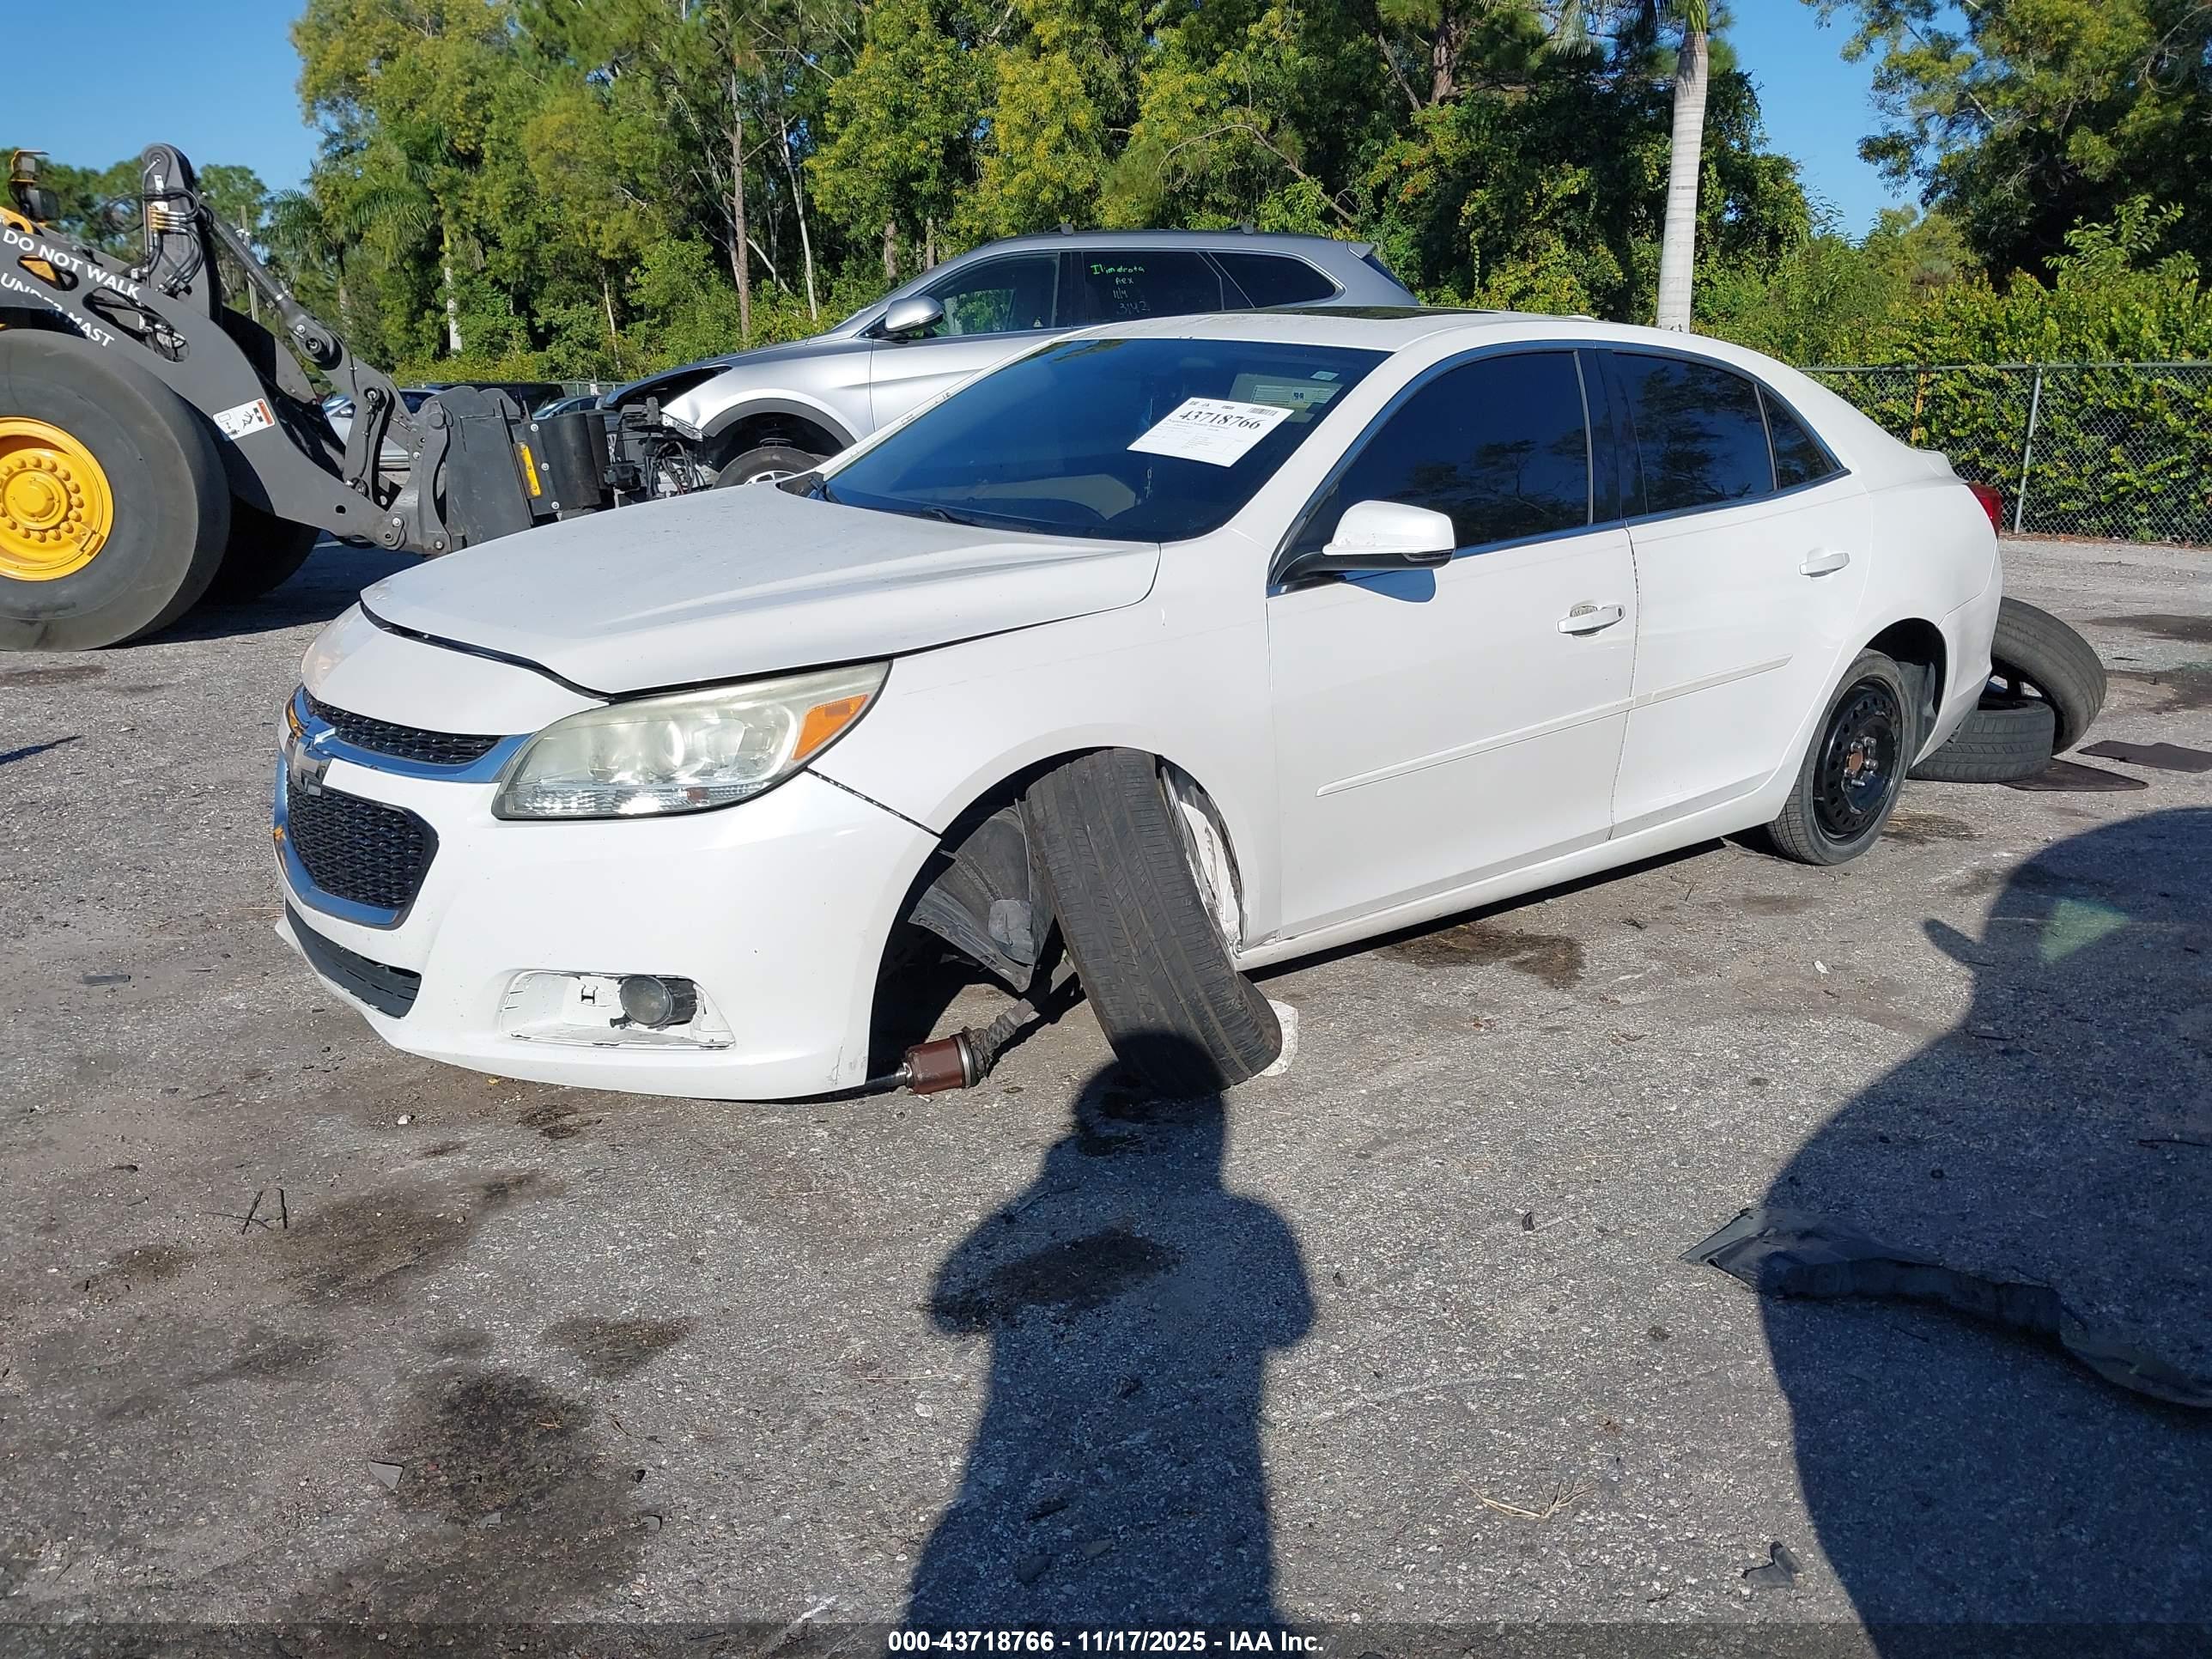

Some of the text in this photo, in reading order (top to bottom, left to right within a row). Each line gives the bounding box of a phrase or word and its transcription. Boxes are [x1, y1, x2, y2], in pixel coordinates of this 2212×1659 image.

[3, 229, 141, 301] DO NOT WALK
[67, 312, 115, 347] MAST
[1179, 410, 1267, 429] 43718766
